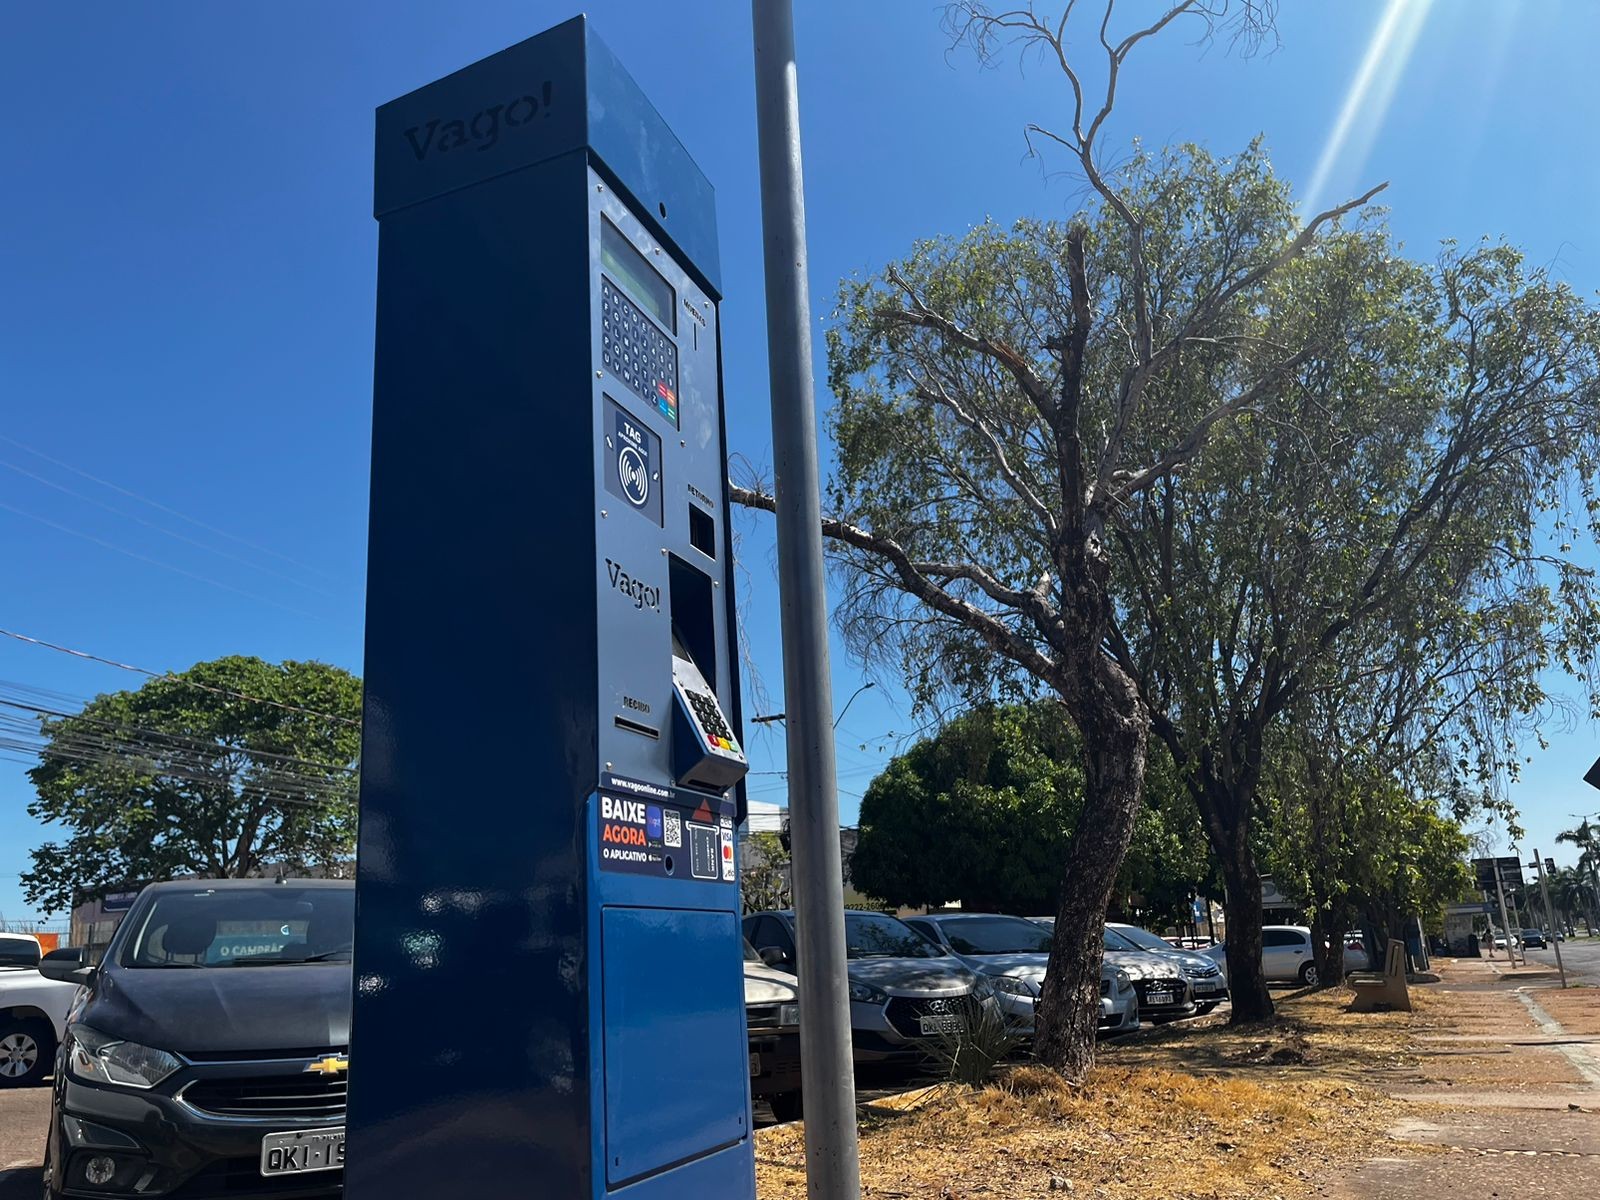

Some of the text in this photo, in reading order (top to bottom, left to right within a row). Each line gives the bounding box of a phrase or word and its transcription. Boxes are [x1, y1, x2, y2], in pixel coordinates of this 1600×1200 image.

[403, 80, 553, 161] Vago!
[624, 422, 641, 444] TAG
[605, 557, 660, 613] Vago!
[623, 696, 650, 713] RECIBO
[602, 796, 646, 825] BAIXE
[603, 823, 646, 846] AGORA
[721, 831, 732, 842] VISA
[603, 848, 609, 858] O
[610, 849, 647, 862] APLICATIVO
